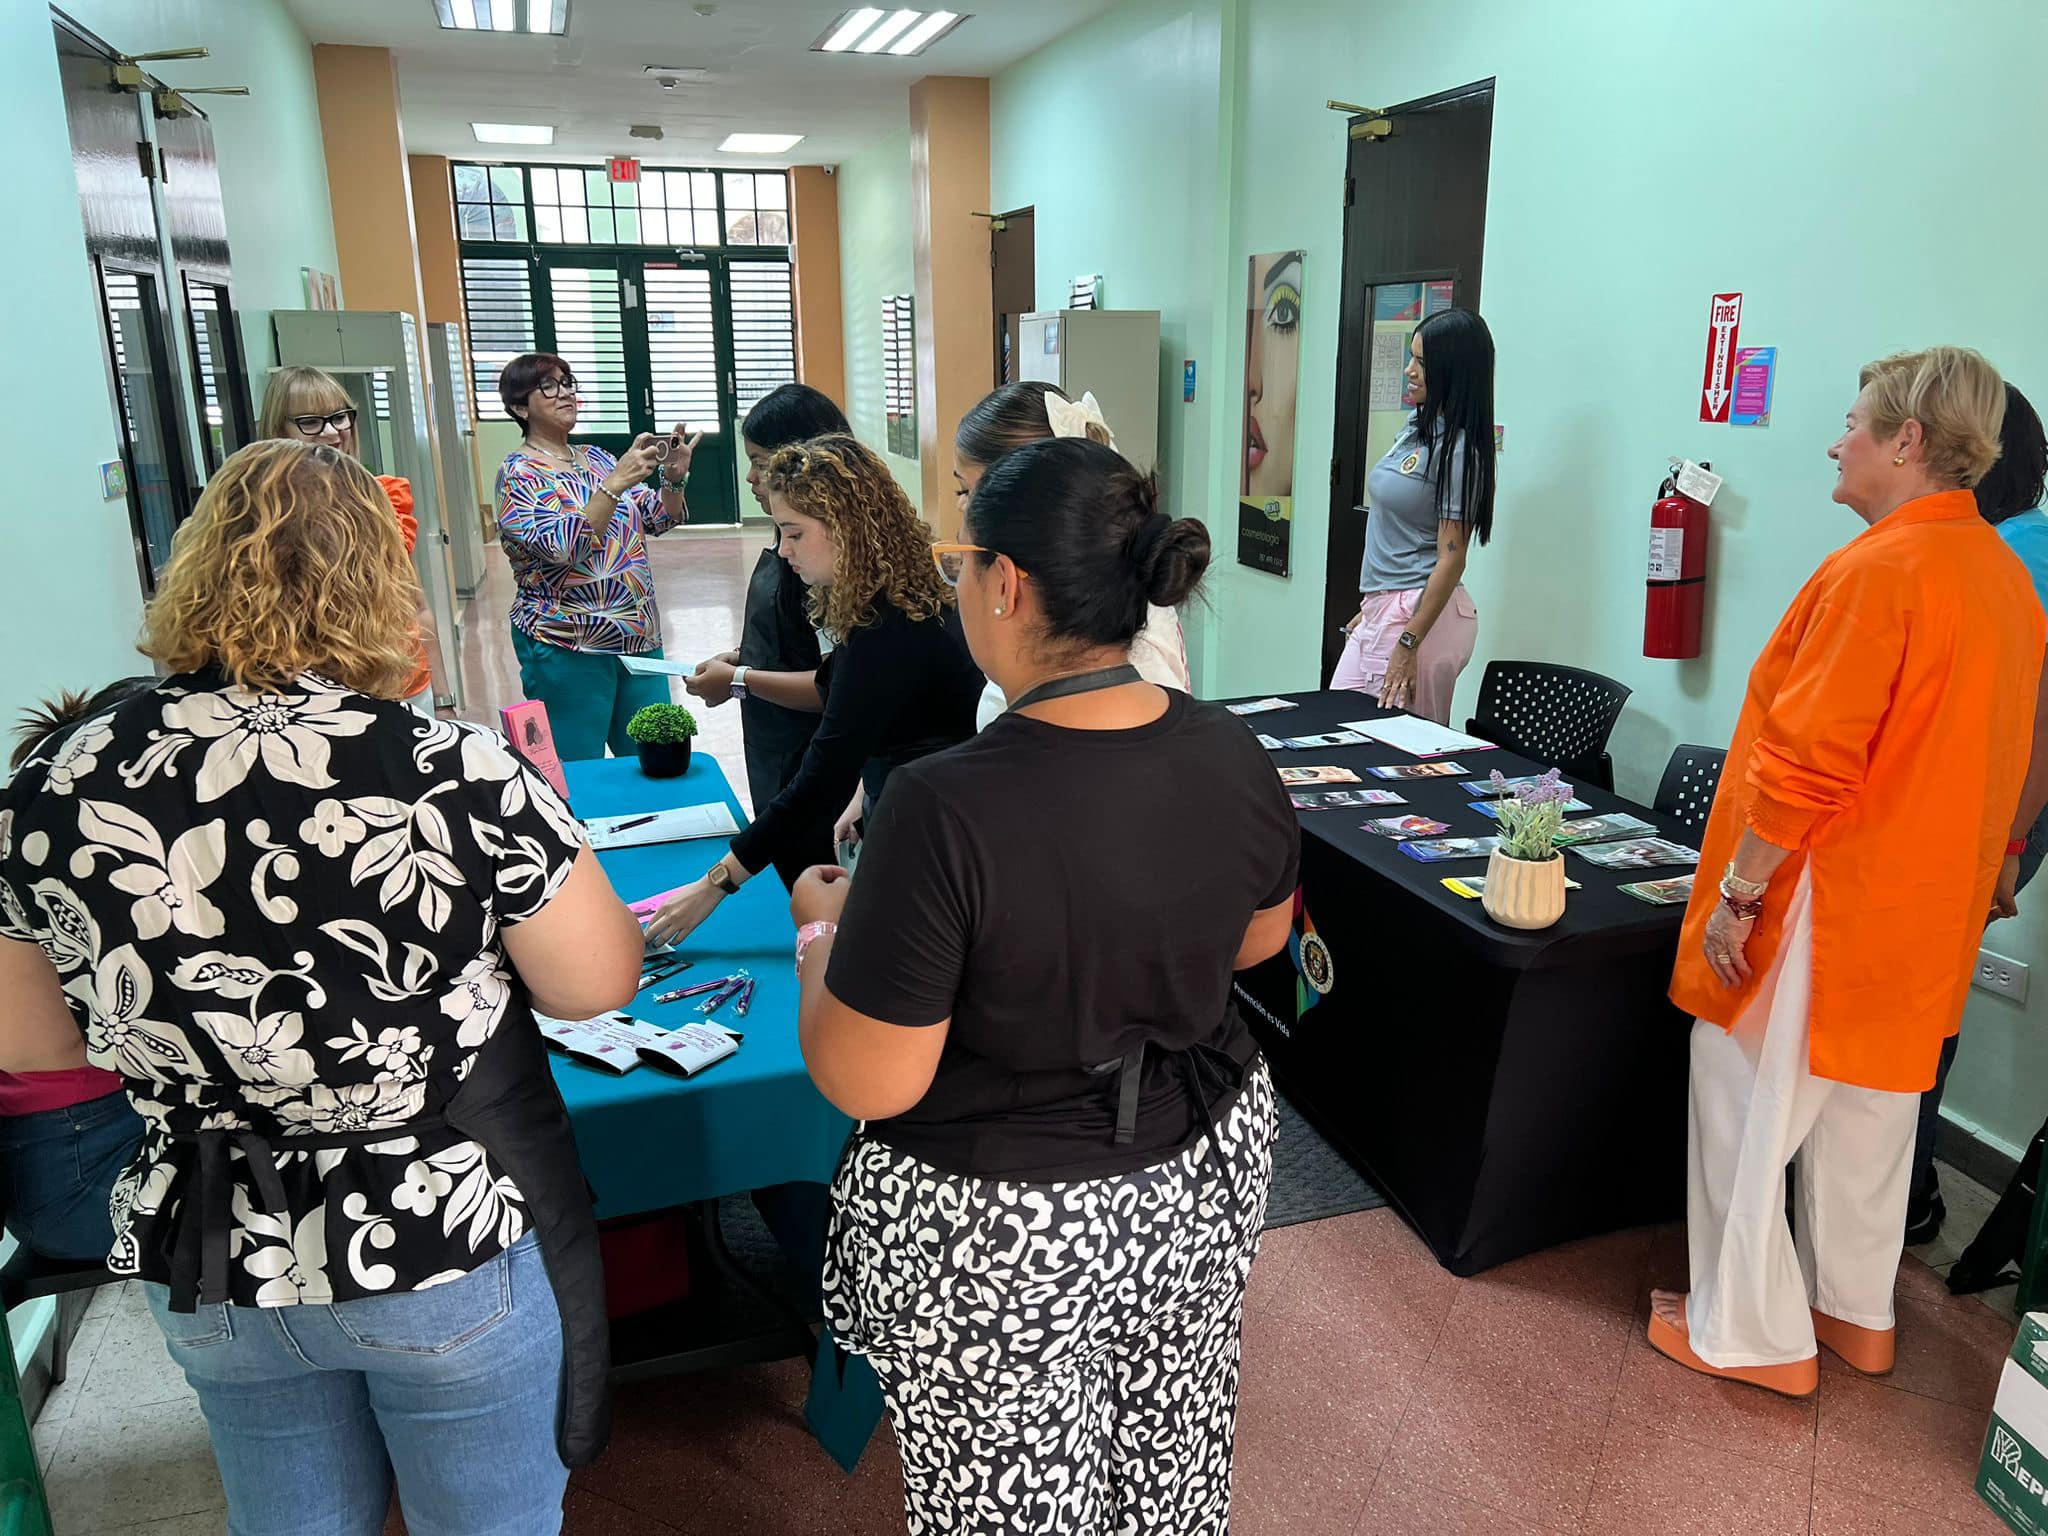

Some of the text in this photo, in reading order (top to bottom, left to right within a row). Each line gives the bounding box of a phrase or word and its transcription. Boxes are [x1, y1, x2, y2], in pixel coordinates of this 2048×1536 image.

[611, 160, 637, 180] EXIT
[1714, 304, 1737, 323] FIRE
[1712, 325, 1727, 411] EXTINGUISHER
[1275, 1016, 1290, 1038] Vida
